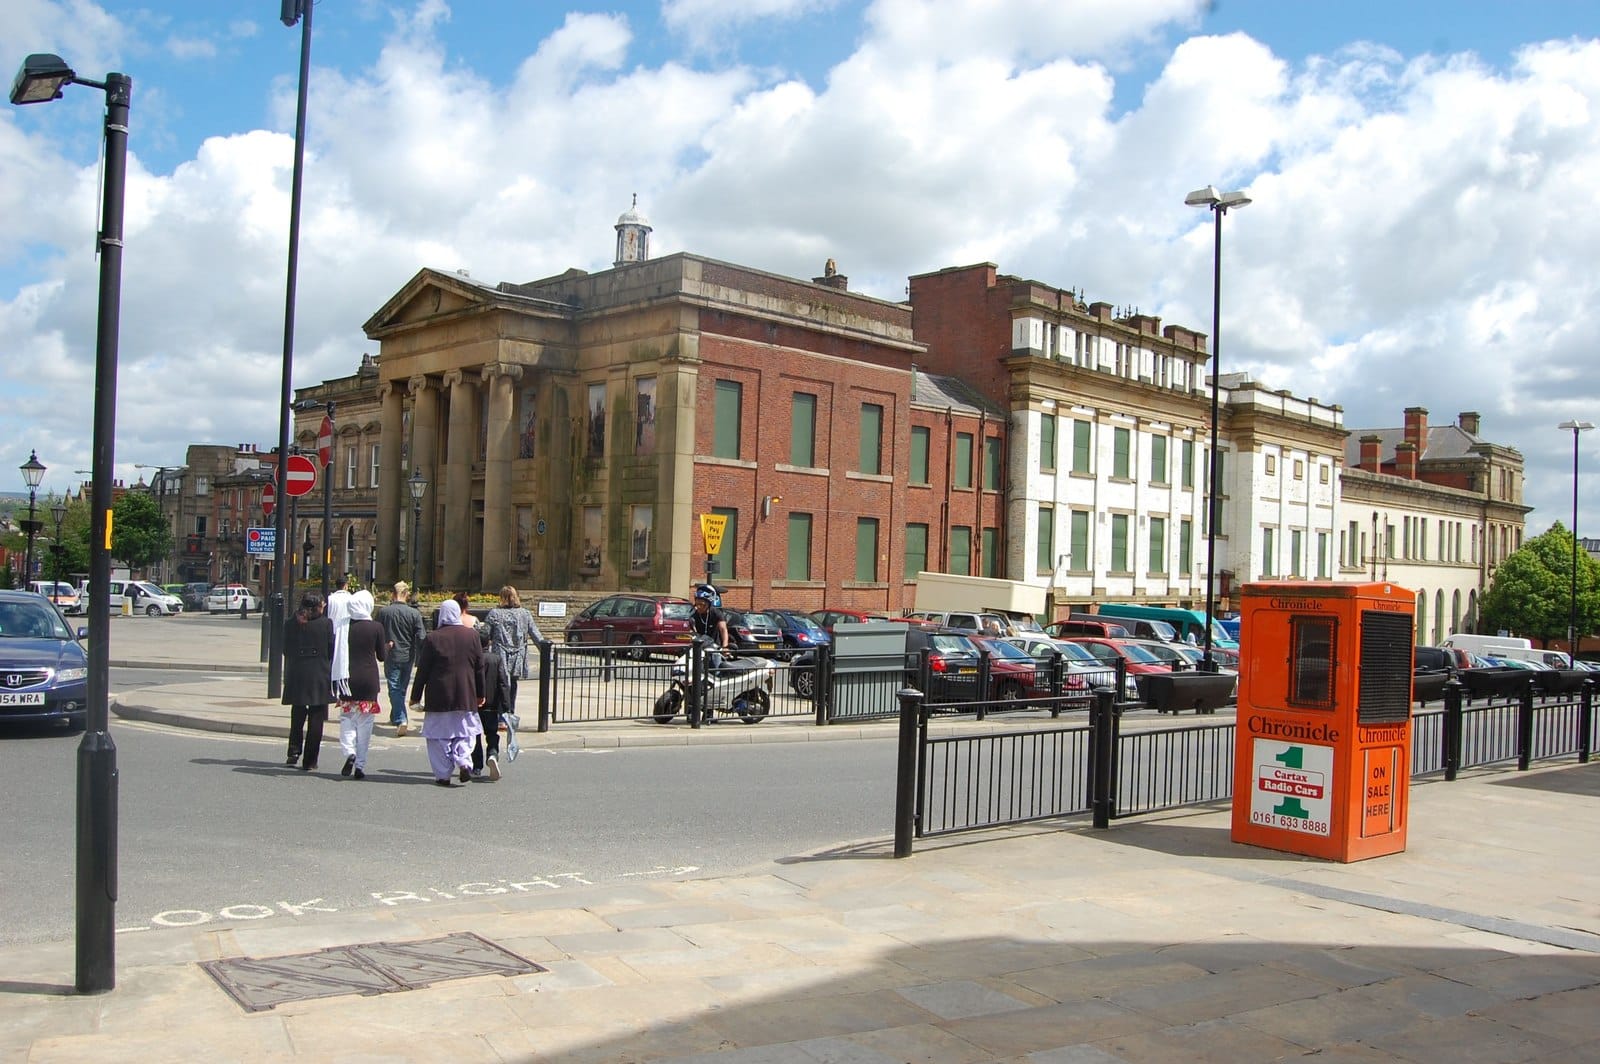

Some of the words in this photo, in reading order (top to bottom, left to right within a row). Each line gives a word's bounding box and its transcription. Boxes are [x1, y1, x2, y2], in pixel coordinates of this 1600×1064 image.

[709, 526, 719, 534] Pay
[1270, 598, 1322, 609] Chronicle
[20, 693, 39, 703] WRA
[1248, 715, 1339, 742] Chronicle
[1358, 723, 1406, 743] Chronicle
[1274, 770, 1308, 782] Cartax
[1373, 766, 1385, 779] ON
[1264, 780, 1292, 792] Radio
[1294, 785, 1318, 796] Cars
[1367, 785, 1389, 798] SALE
[1366, 803, 1389, 817] HERE
[1253, 811, 1275, 824] 0161
[1280, 815, 1298, 828] 633
[1302, 819, 1327, 833] 8888
[370, 872, 594, 906] RIGHT
